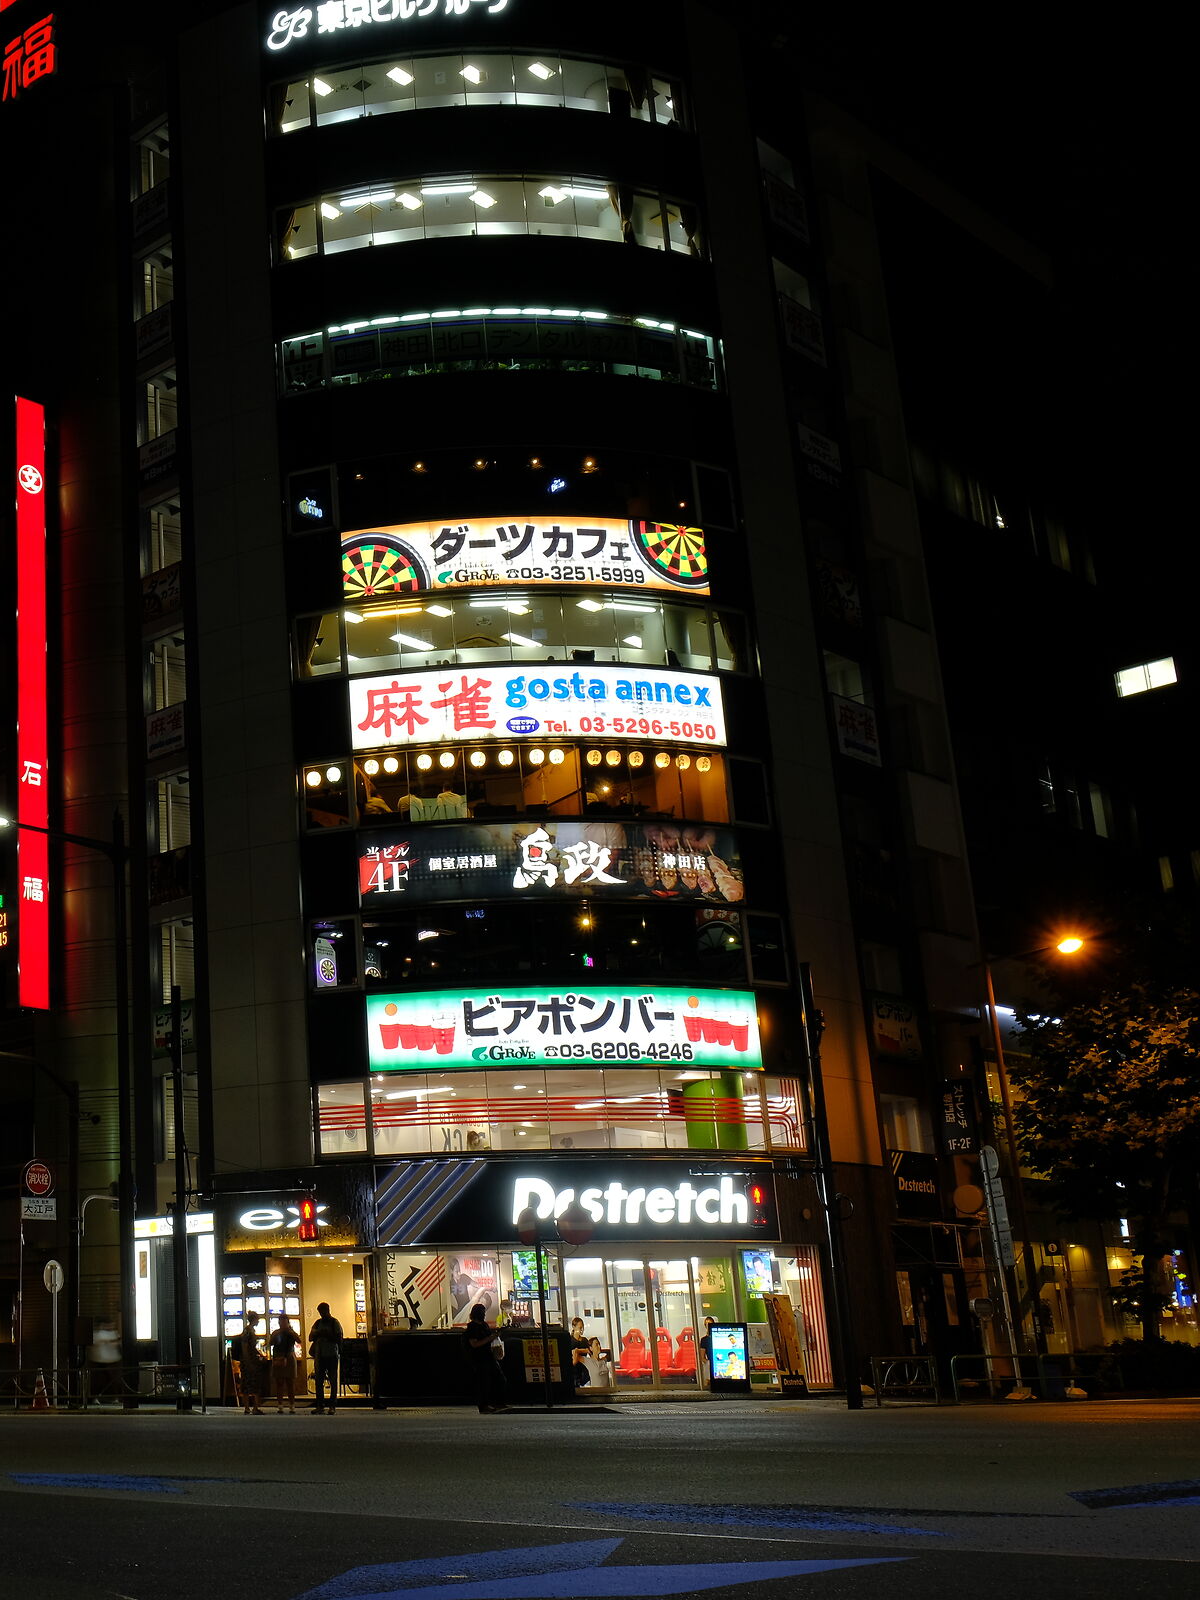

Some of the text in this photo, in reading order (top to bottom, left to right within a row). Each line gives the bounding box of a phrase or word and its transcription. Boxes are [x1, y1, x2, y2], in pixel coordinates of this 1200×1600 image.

[429, 523, 632, 566] ダーツカフェ
[520, 565, 645, 585] 03-3251-5999
[505, 672, 712, 710] gosta annex
[357, 674, 497, 739] 麻雀
[544, 716, 717, 740] Tel. 03-5296-5050
[366, 845, 410, 862] 当ビル
[428, 854, 498, 872] 個室居酒屋
[512, 827, 628, 889] 鳥政
[662, 854, 707, 872] 神田店
[367, 859, 410, 893] 4F
[463, 994, 675, 1036] ビアポンバー
[560, 1042, 693, 1061] 03-6206-4246
[953, 1084, 968, 1129] ストレッチ
[28, 1172, 49, 1186] 消火栓
[23, 1204, 54, 1214] 大江戸
